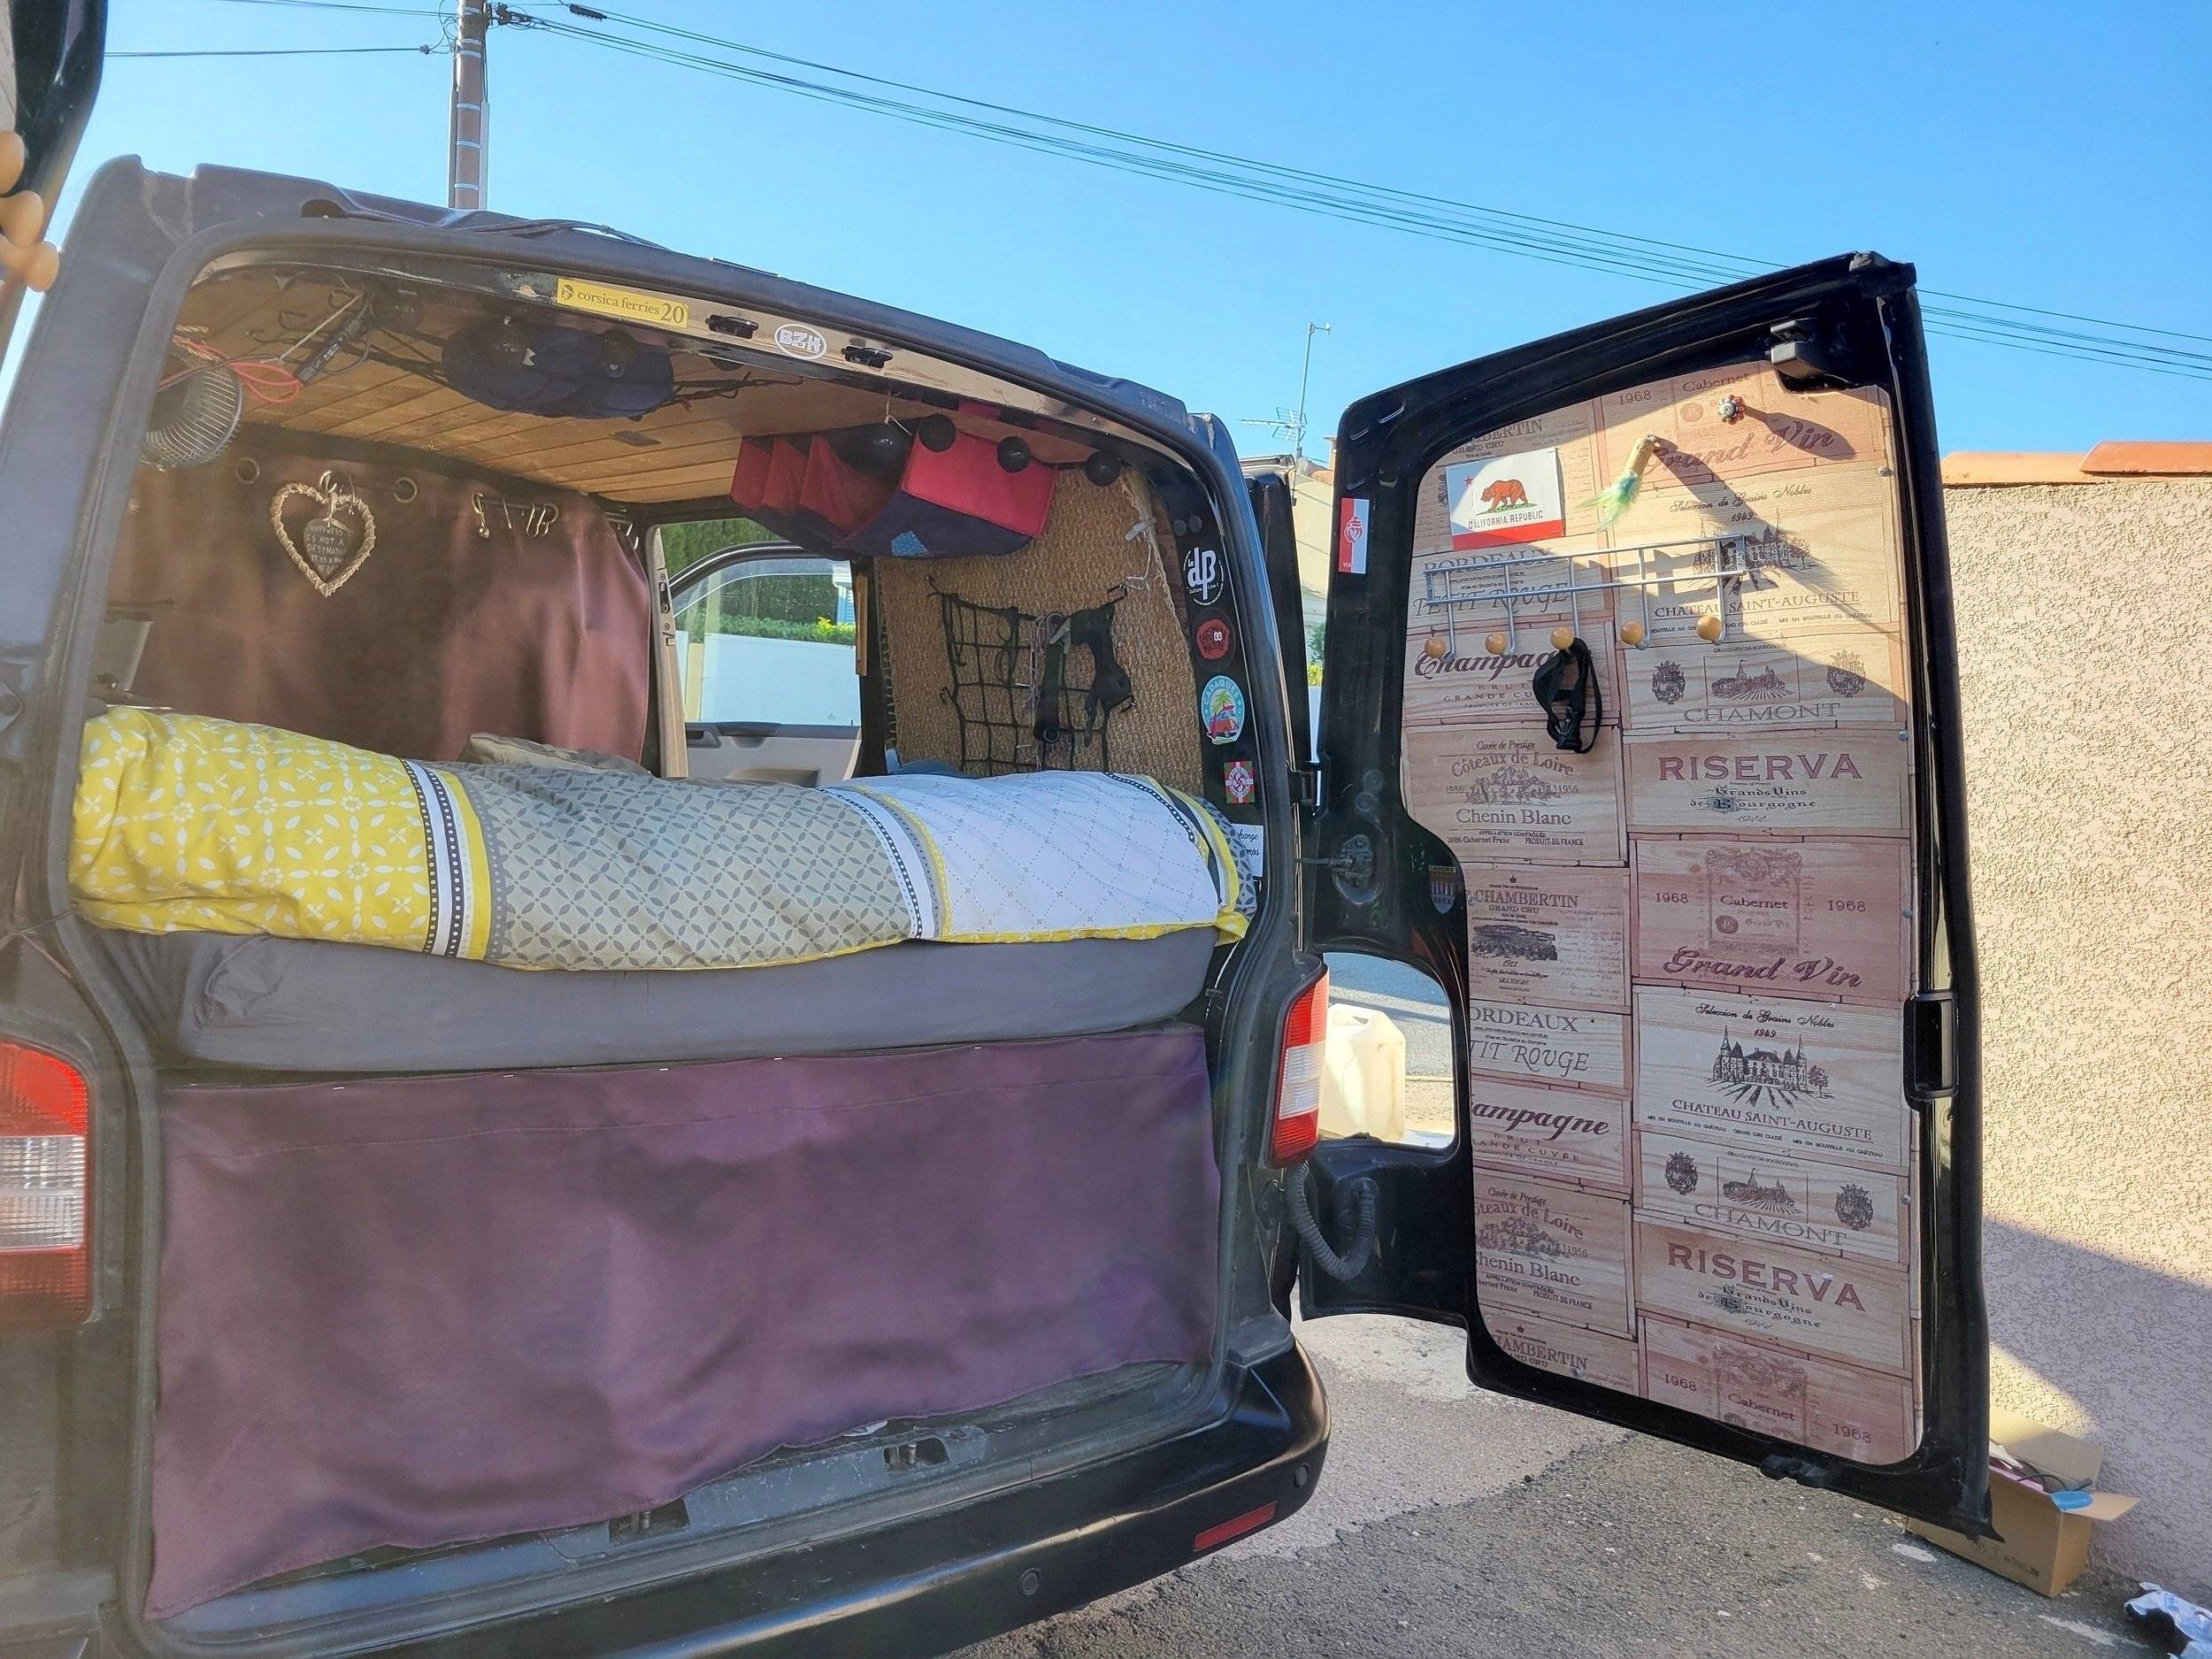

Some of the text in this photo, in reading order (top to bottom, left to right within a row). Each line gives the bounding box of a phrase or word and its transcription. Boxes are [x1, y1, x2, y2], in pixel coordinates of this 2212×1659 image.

[578, 291, 685, 324] corsica ferries 20
[1683, 373, 1751, 393] Cabernet
[1618, 389, 1652, 405] 1968
[1764, 419, 1836, 455] Vin
[1468, 510, 1544, 530] CALIFORNIA REPUBLIC
[1424, 547, 1558, 575] BORDEAUX
[1413, 582, 1569, 617] PETIT ROUGE
[1729, 591, 1860, 614] SAINT-AUGUSTE
[1414, 649, 1558, 683] Champa
[1443, 692, 1506, 703] GRANDE
[1683, 702, 1841, 724] CHAMONT
[1498, 740, 1506, 749] de
[1508, 739, 1536, 751] Prestige
[1450, 750, 1574, 778] Côteaux de Loire
[1657, 753, 1863, 780] RISERVA
[1714, 784, 1808, 797] Grands Vins
[1713, 797, 1816, 811] Bourgogne
[1455, 808, 1572, 826] Chenin Blanc
[1474, 889, 1579, 909] CHAMBERTIN
[1488, 904, 1519, 913] GRAND
[1655, 892, 1689, 904] 1968
[1719, 895, 1789, 910] Cabernet
[1826, 898, 1867, 912] 1968
[1663, 945, 1786, 982] Grand
[1793, 956, 1863, 987] Vin
[1470, 1006, 1579, 1033] ORDEAUX
[1742, 1010, 1754, 1020] de
[1756, 1009, 1792, 1025] Grains
[1797, 1014, 1836, 1029] Nobles
[1470, 1039, 1590, 1078] TIT ROUGE
[1471, 1102, 1610, 1141] ampagne
[1671, 1099, 1873, 1141] CHATEAU SAINT-AUGUSTE
[1472, 1138, 1521, 1151] ANDE
[1519, 1192, 1548, 1207] Prestige
[1475, 1202, 1585, 1240] teaux de Loire
[1694, 1203, 1847, 1247] CHAMONT
[1477, 1250, 1581, 1286] henin Blanc
[1667, 1241, 1866, 1312] RISERVA
[1664, 1373, 1697, 1392] 1968
[1727, 1393, 1797, 1422] Cabernet
[1832, 1422, 1872, 1444] 1968
